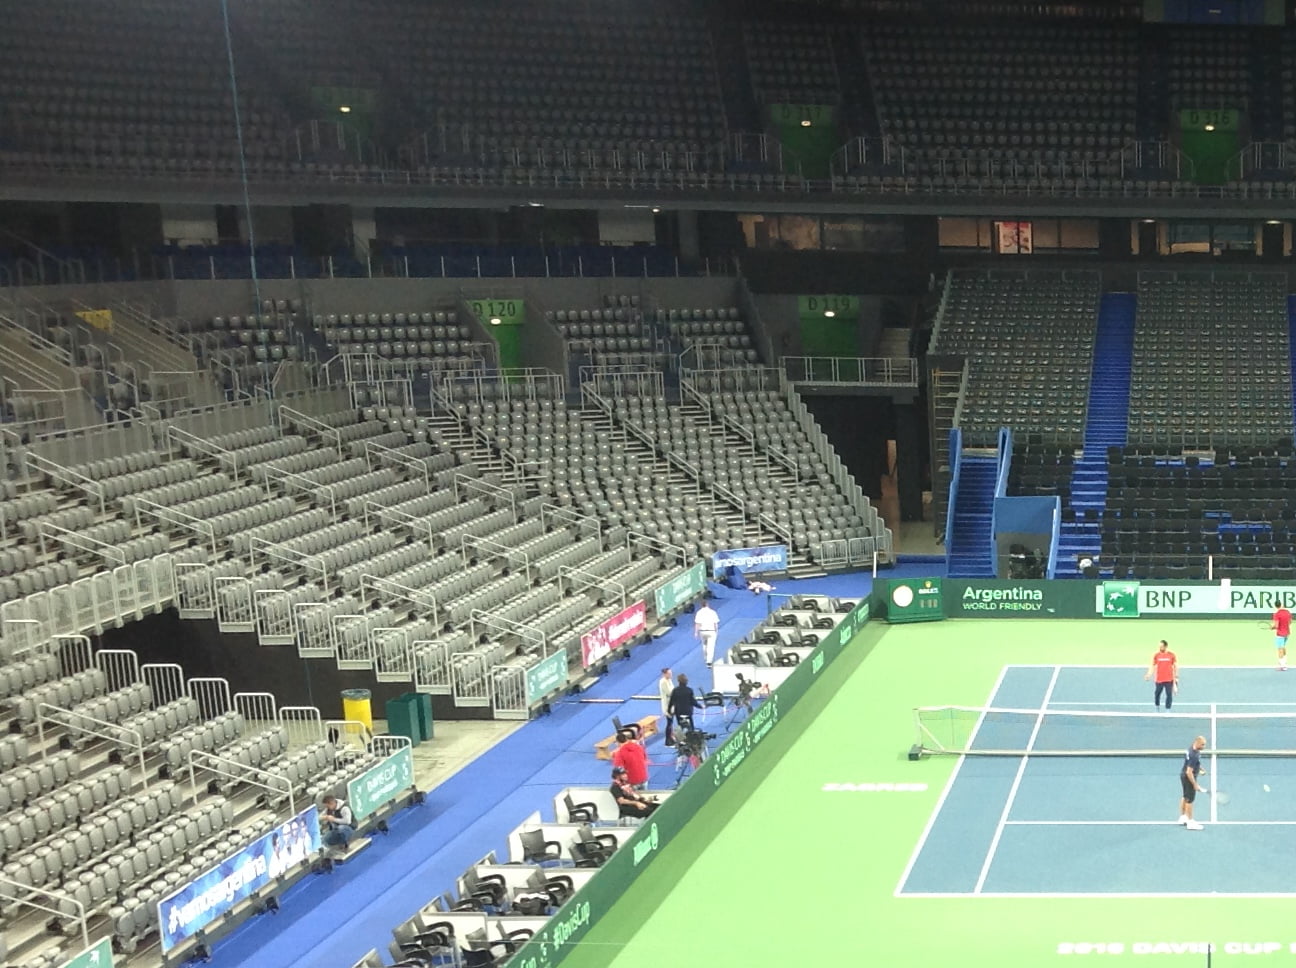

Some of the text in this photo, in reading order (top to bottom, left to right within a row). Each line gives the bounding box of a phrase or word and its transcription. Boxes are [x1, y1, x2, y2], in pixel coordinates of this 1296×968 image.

[488, 302, 516, 317] 120
[962, 586, 1043, 602] Argentina
[1145, 590, 1192, 608] BNP
[962, 602, 1042, 611] WORLD FRIENDLY
[1223, 942, 1281, 954] CUP
